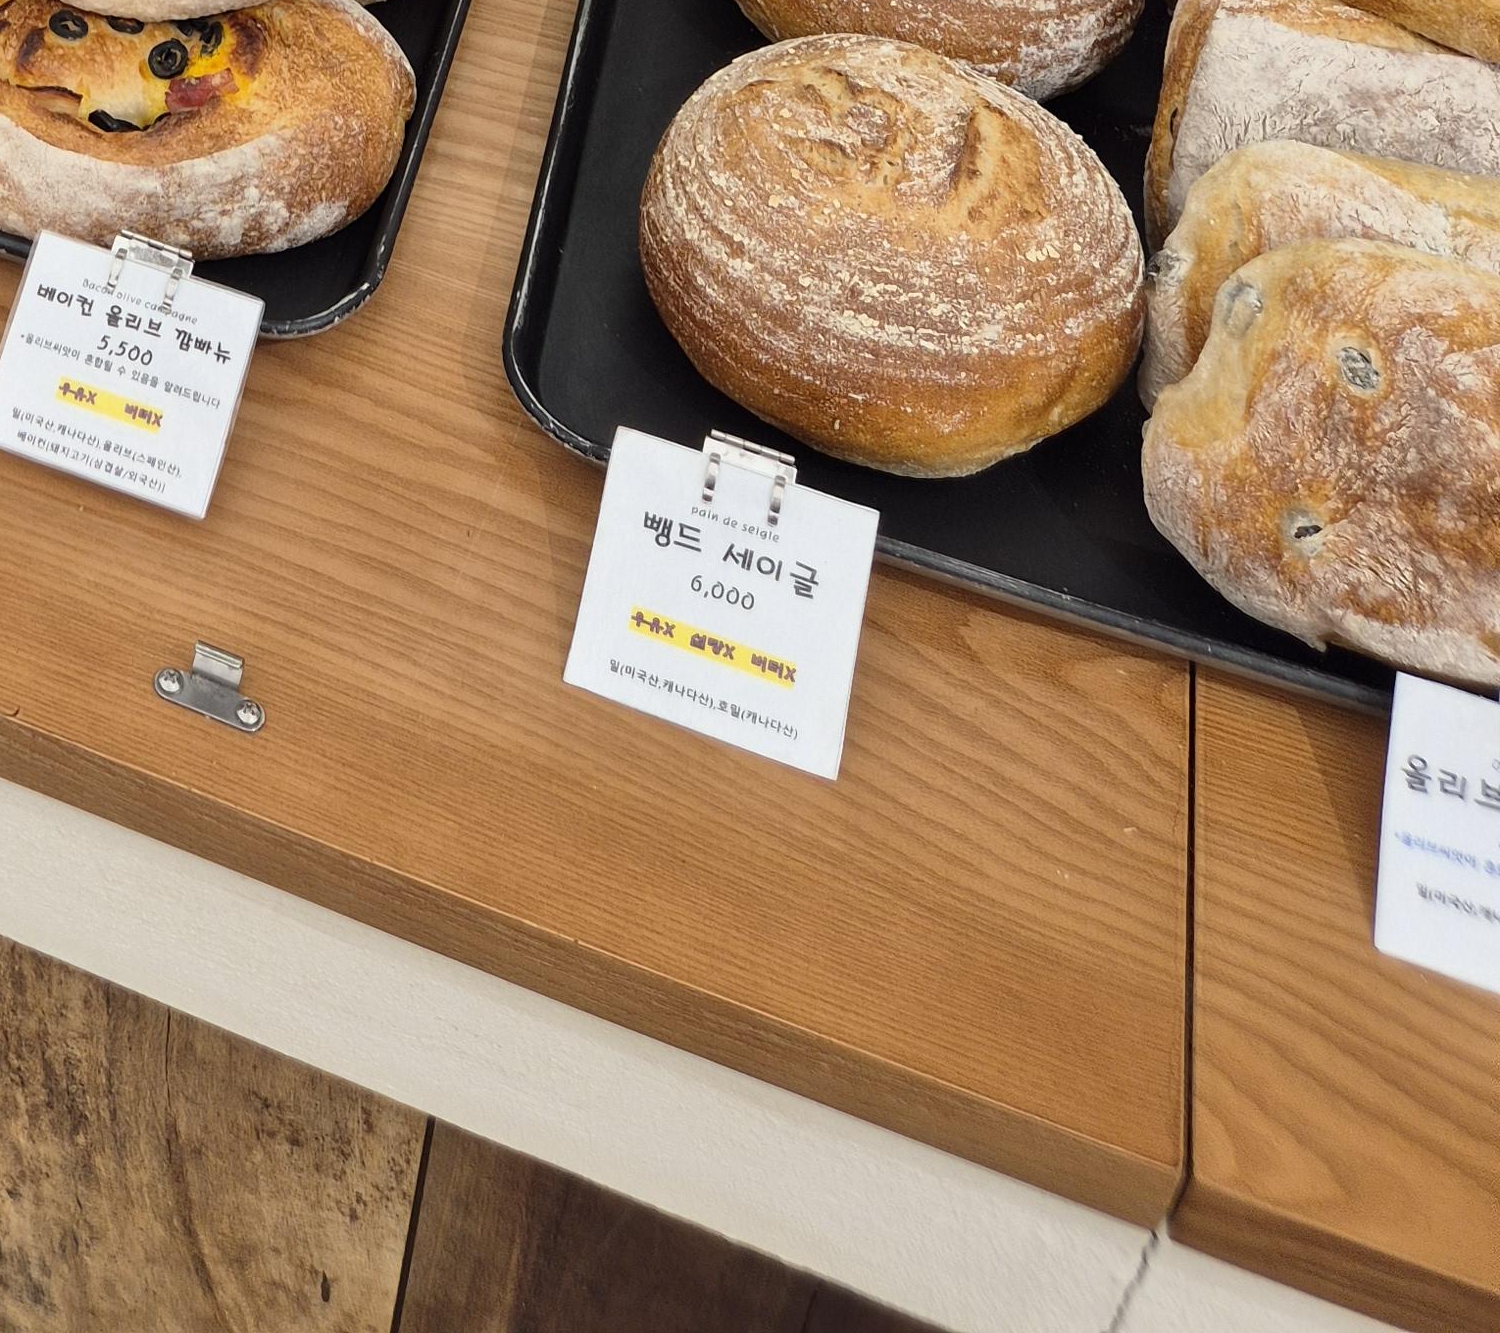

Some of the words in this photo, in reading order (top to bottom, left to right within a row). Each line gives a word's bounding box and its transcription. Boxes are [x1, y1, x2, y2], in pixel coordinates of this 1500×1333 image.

[115, 290, 142, 306] olive
[37, 284, 94, 316] 베이컨
[106, 305, 162, 337] 올리브
[175, 328, 230, 364] 깜빠뉴
[97, 335, 152, 365] 5,500
[117, 366, 125, 376] 수
[690, 505, 719, 522] pain
[722, 515, 737, 528] de
[741, 522, 780, 543] seigle
[644, 512, 701, 552] 뺑드
[723, 544, 818, 599] 세이글
[691, 575, 754, 610] 6,000
